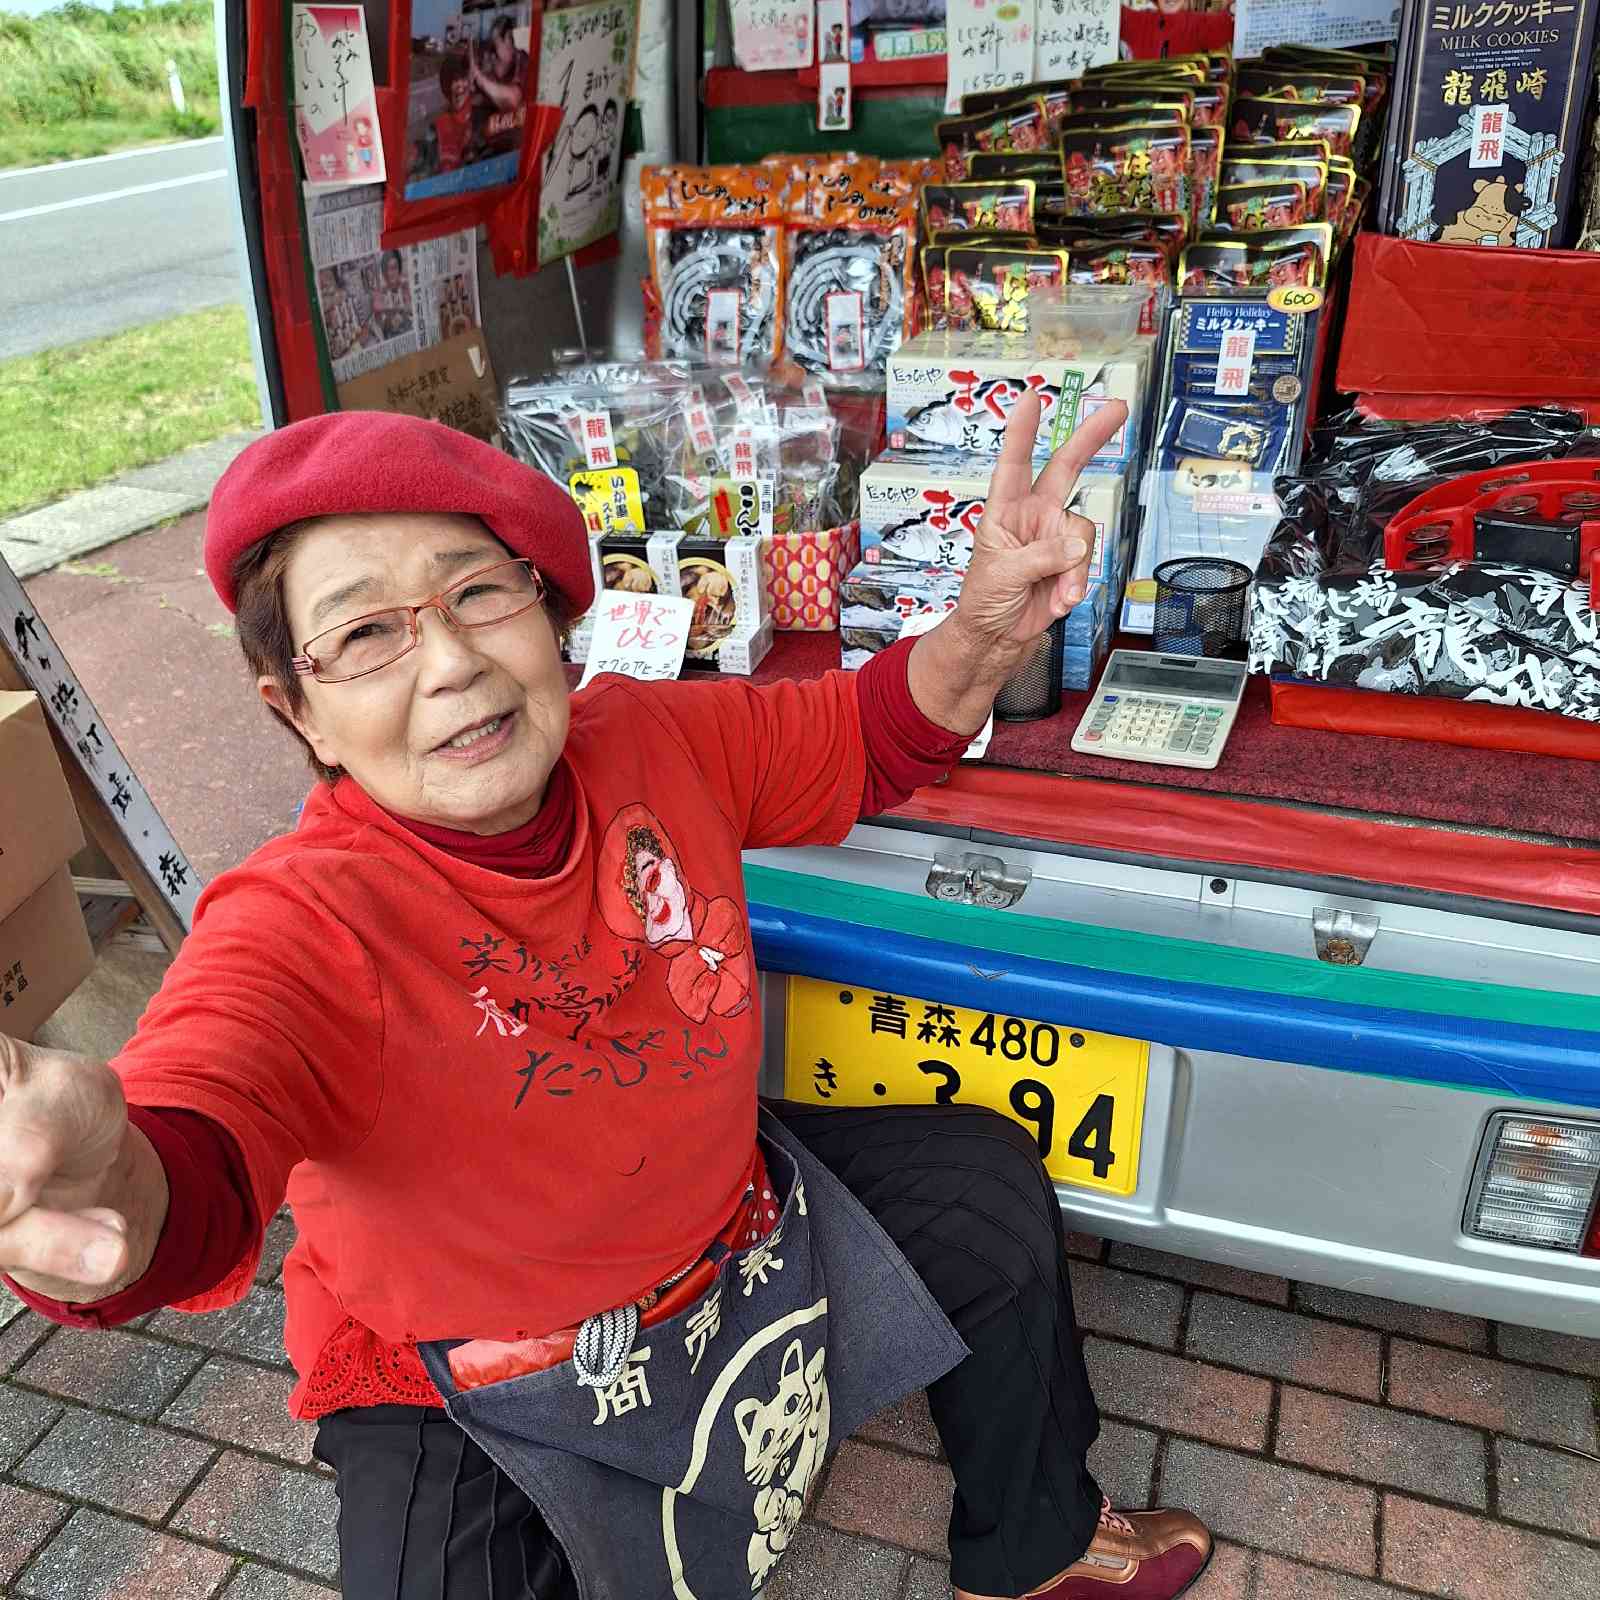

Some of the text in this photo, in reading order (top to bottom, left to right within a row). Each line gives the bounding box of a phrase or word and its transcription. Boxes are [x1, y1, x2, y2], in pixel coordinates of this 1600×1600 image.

[1431, 0, 1575, 31] ミルククッキー
[1440, 28, 1560, 51] MILK COOKIES
[1441, 67, 1548, 105] 龍飛崎
[1477, 112, 1504, 160] 龍飛
[1206, 307, 1272, 319] Hello Holiday
[1283, 291, 1316, 306] 600
[1196, 318, 1280, 332] ミルククッキー
[1221, 335, 1251, 389] 龍飛
[586, 417, 611, 465] 龍飛
[735, 442, 753, 476] 龍飛
[602, 600, 676, 626] 世界で
[616, 625, 680, 651] ひとつ
[868, 994, 1060, 1068] 青森 480
[812, 1057, 839, 1098] き
